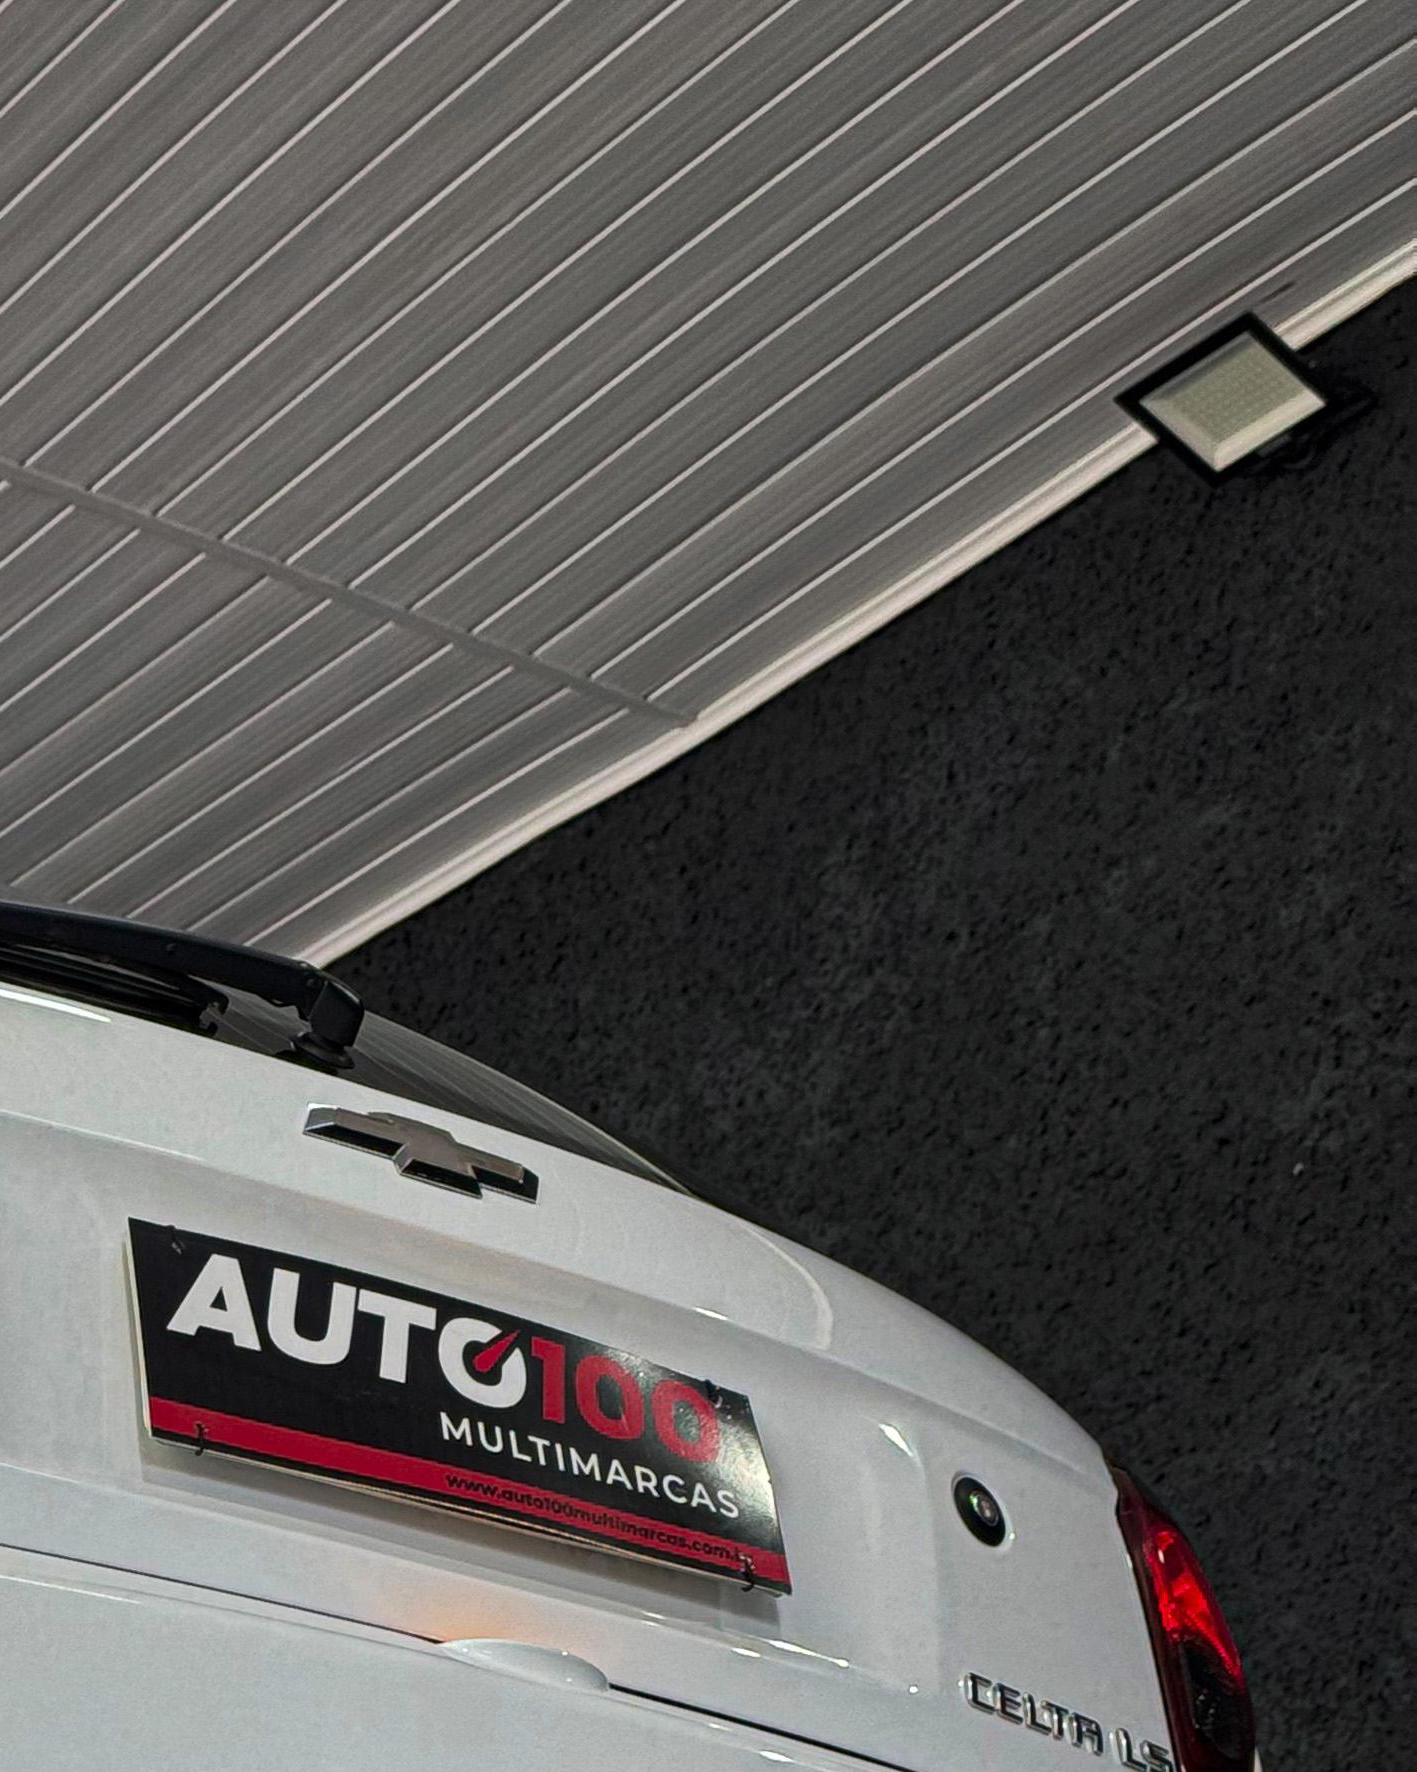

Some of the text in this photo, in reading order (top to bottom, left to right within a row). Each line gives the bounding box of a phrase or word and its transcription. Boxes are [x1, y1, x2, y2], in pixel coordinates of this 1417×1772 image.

[167, 1253, 720, 1463] AUTO100
[439, 1411, 740, 1519] MULTIMARCAS
[445, 1473, 752, 1562] www.auto100multimarcas.com.b
[963, 1671, 1105, 1756] CELTA
